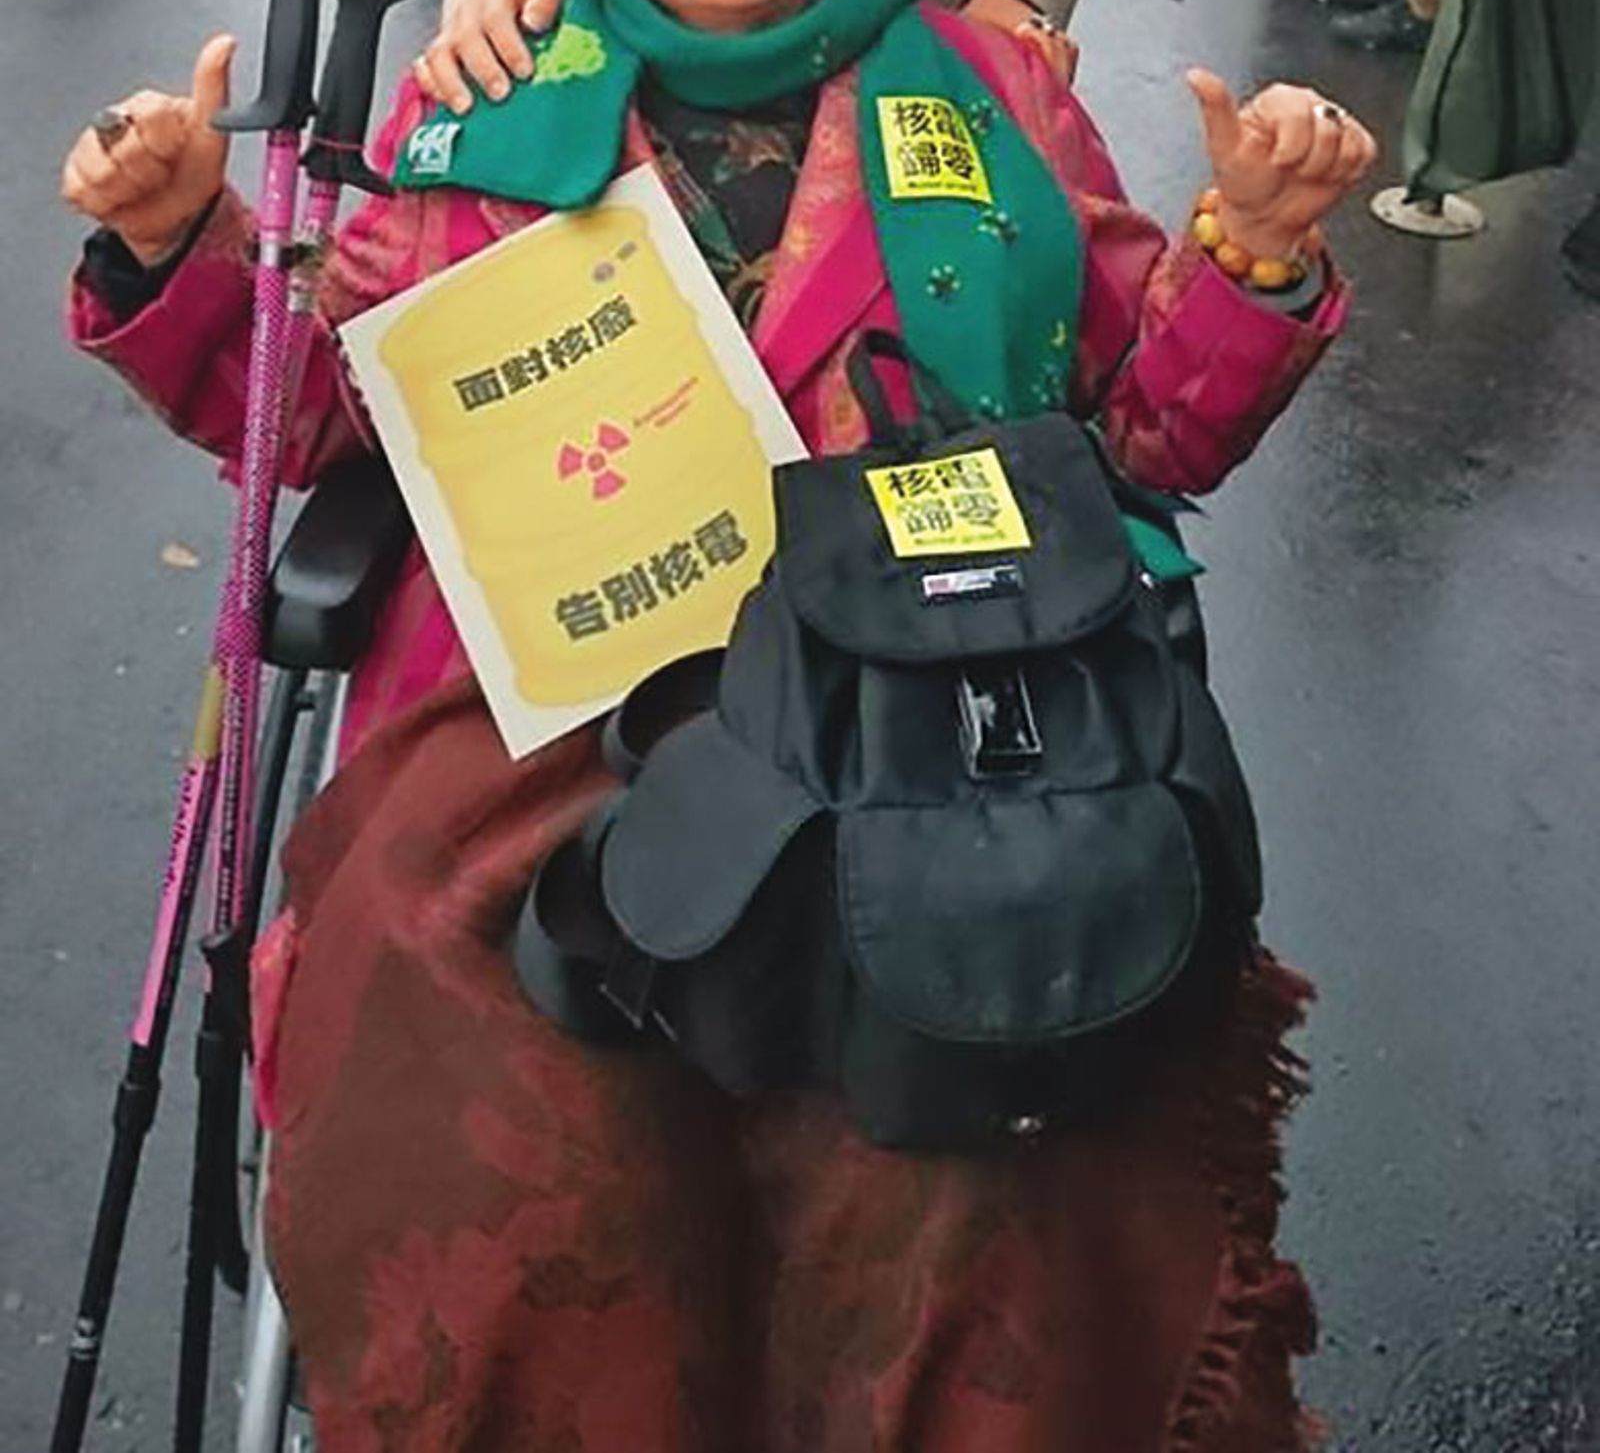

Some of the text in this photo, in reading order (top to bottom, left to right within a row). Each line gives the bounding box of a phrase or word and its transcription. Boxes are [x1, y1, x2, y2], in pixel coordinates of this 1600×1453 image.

[452, 294, 639, 412] 面對核廢
[885, 458, 992, 498] 核電
[555, 509, 748, 641] 告別核電
